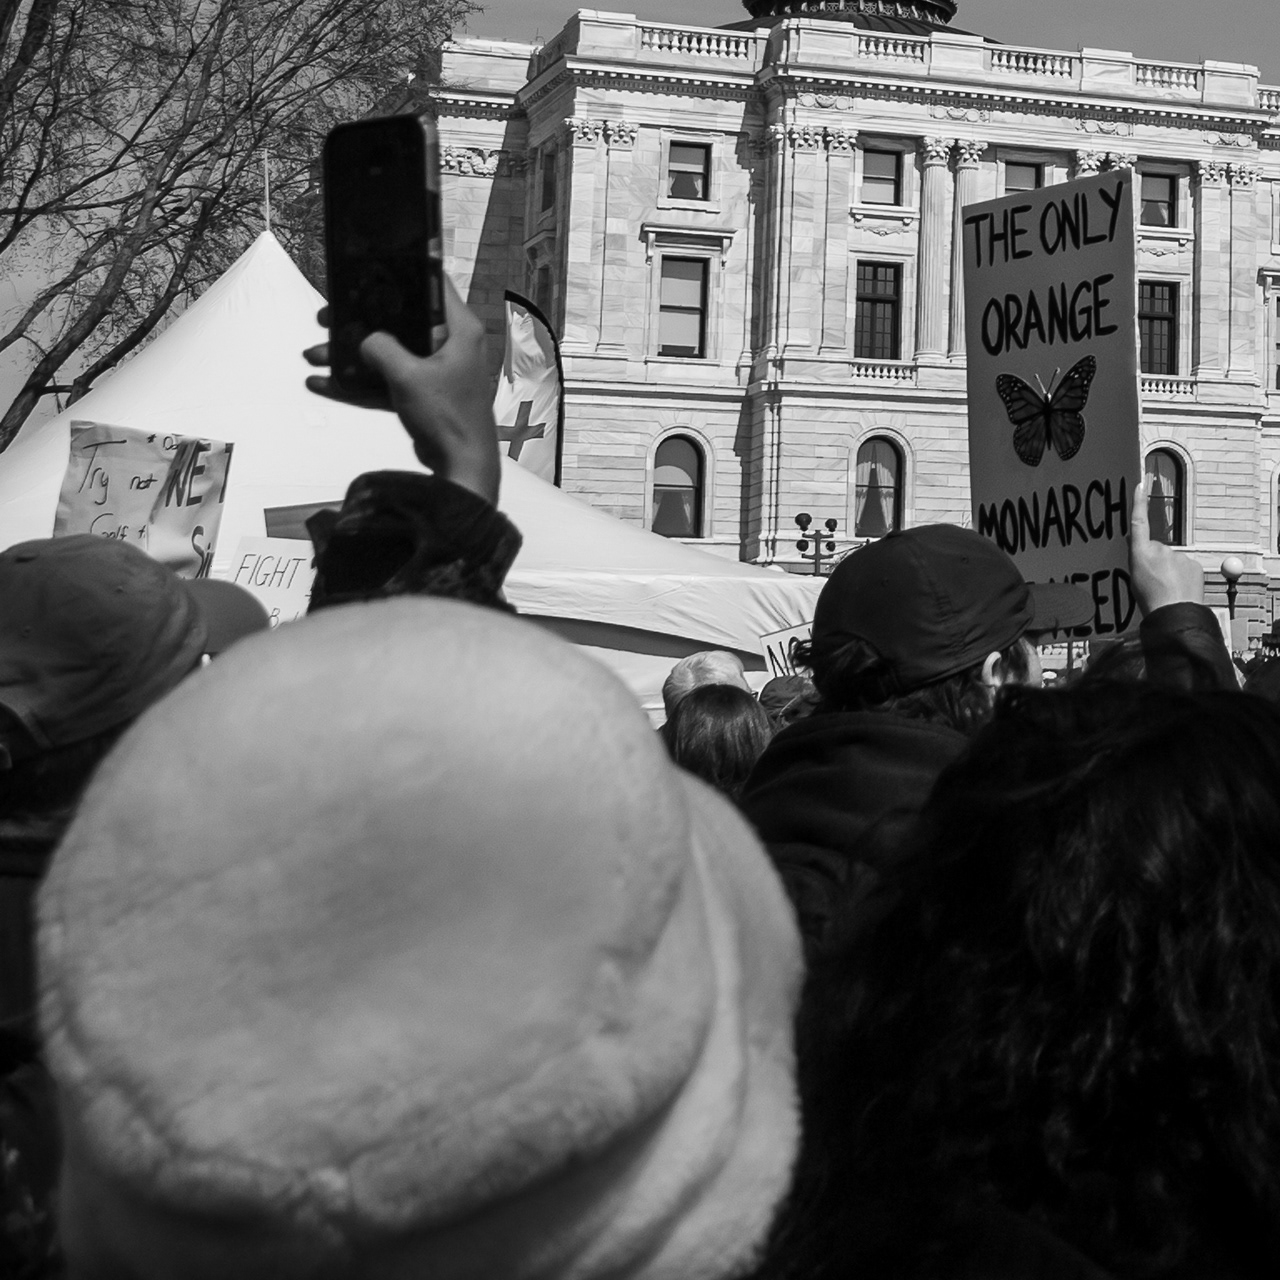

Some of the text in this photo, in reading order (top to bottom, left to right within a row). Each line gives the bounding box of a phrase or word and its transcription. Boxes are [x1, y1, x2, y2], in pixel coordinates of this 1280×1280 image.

[964, 180, 1123, 269] THE ONLY
[981, 273, 1118, 357] ORANGE
[979, 476, 1128, 555] MONARCH
[234, 554, 307, 589] FIGHT
